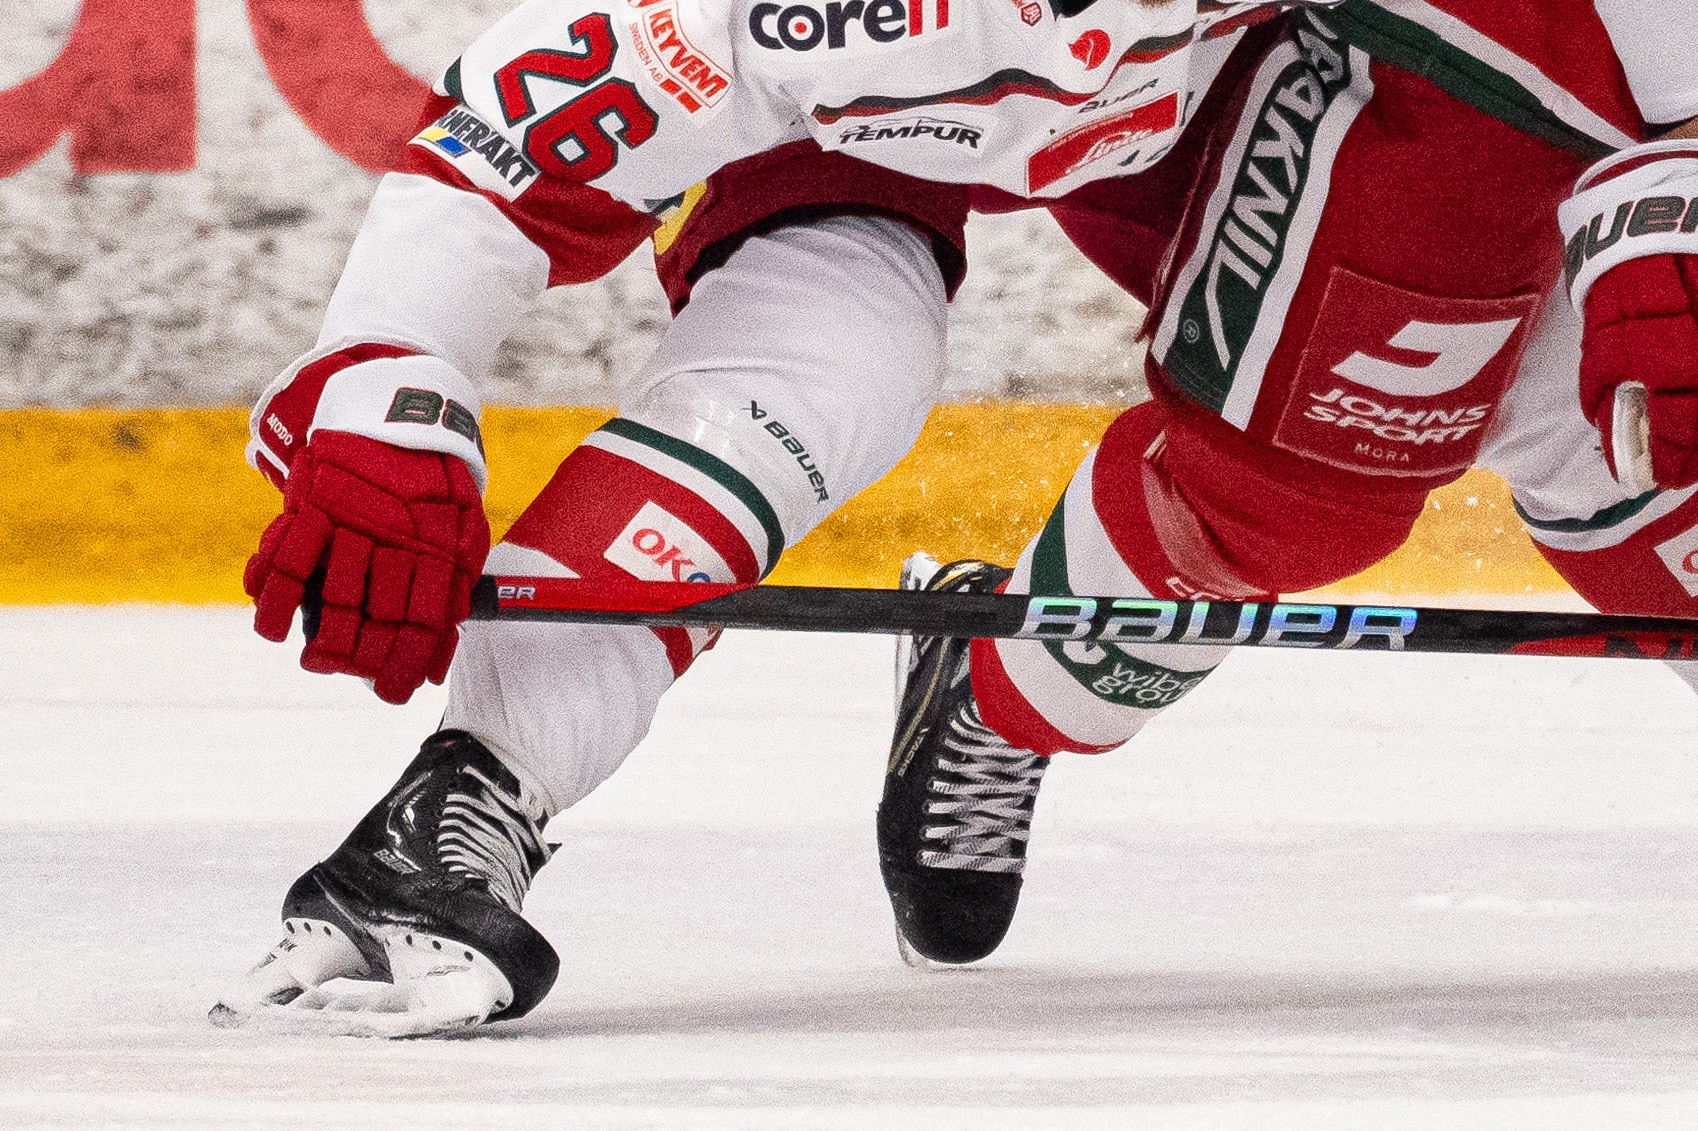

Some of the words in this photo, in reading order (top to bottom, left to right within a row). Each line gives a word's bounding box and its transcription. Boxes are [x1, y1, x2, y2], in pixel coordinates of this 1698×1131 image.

[629, 22, 651, 67] SWEDEN
[649, 7, 730, 99] KEYVENT
[493, 11, 660, 184] 26
[839, 124, 983, 150] TEMPUR
[1302, 404, 1485, 447] SPORT
[1308, 387, 1494, 425] JOHNS
[266, 413, 294, 447] MODO
[764, 420, 831, 504] BAUER
[1353, 441, 1412, 464] MORA
[1018, 594, 1419, 652] BAUER
